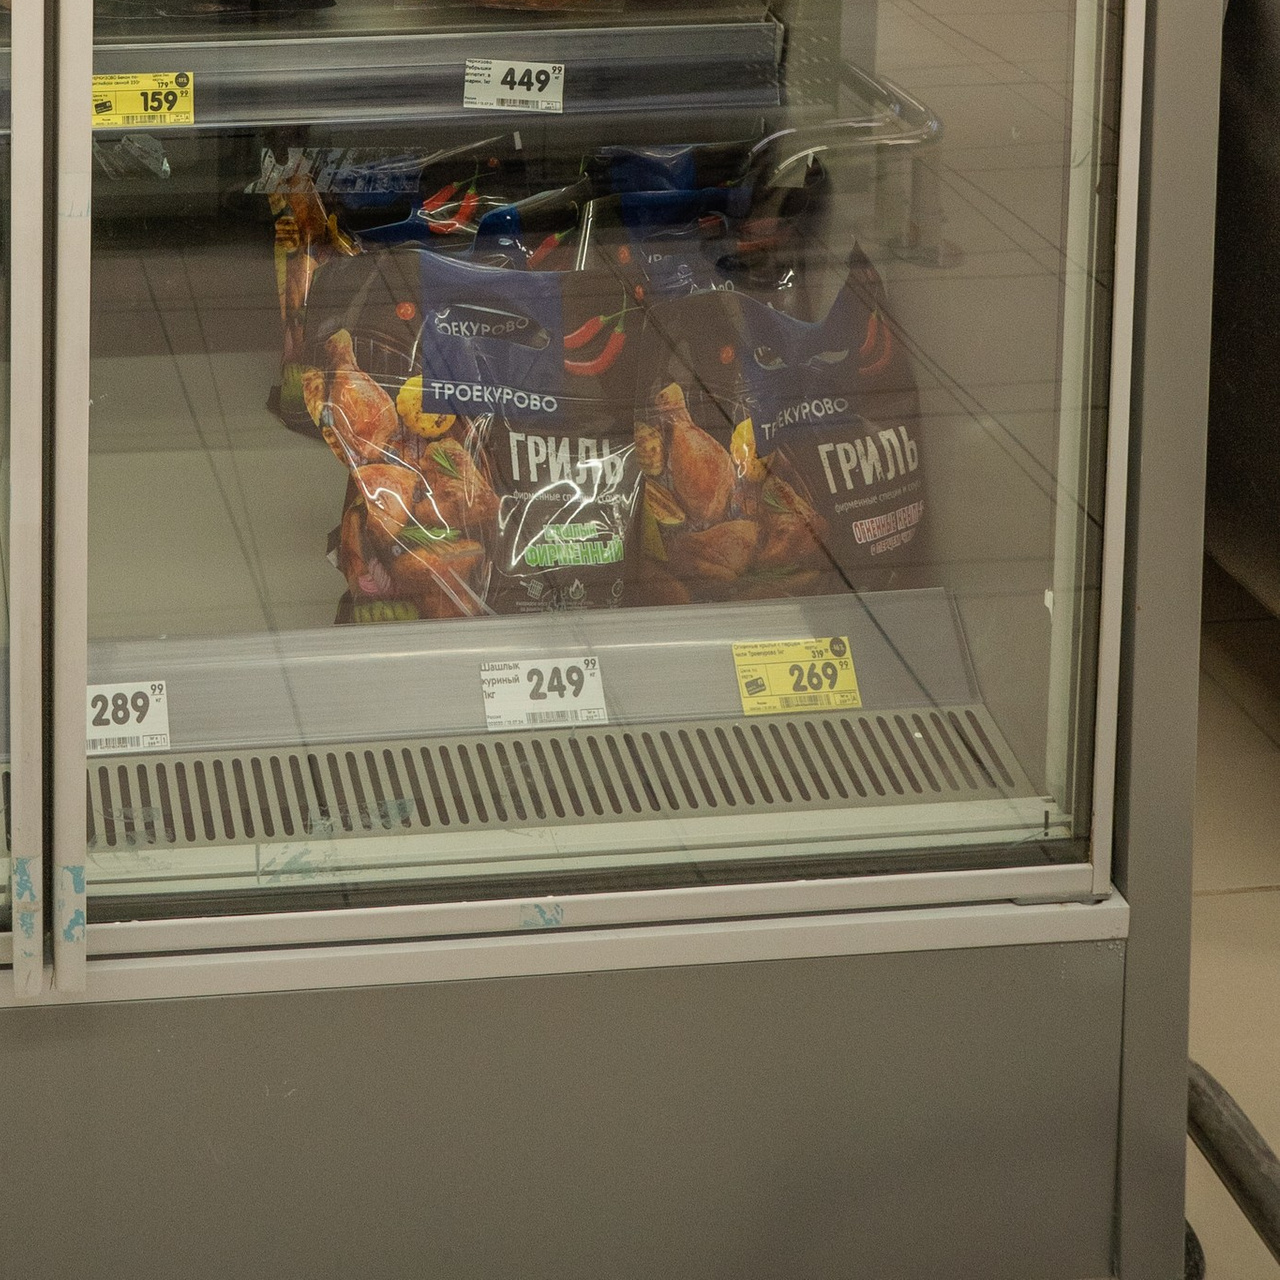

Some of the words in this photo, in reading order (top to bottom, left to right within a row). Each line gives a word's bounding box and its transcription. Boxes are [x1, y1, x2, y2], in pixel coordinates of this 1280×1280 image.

[500, 67, 550, 92] 449
[551, 65, 563, 75] 99
[140, 90, 178, 112] 159
[431, 383, 558, 413] ТРОЕКУРОВО
[509, 431, 625, 486] ГРИЛЬ
[818, 426, 919, 494] ГРИЛЬ
[524, 535, 624, 567] ФИРМЕННЫЙ
[480, 661, 520, 672] Шашлык
[526, 665, 585, 701] 249
[583, 658, 597, 669] 99
[788, 661, 838, 692] 269
[839, 660, 849, 669] 99
[91, 691, 150, 727] 289
[150, 683, 164, 694] 99
